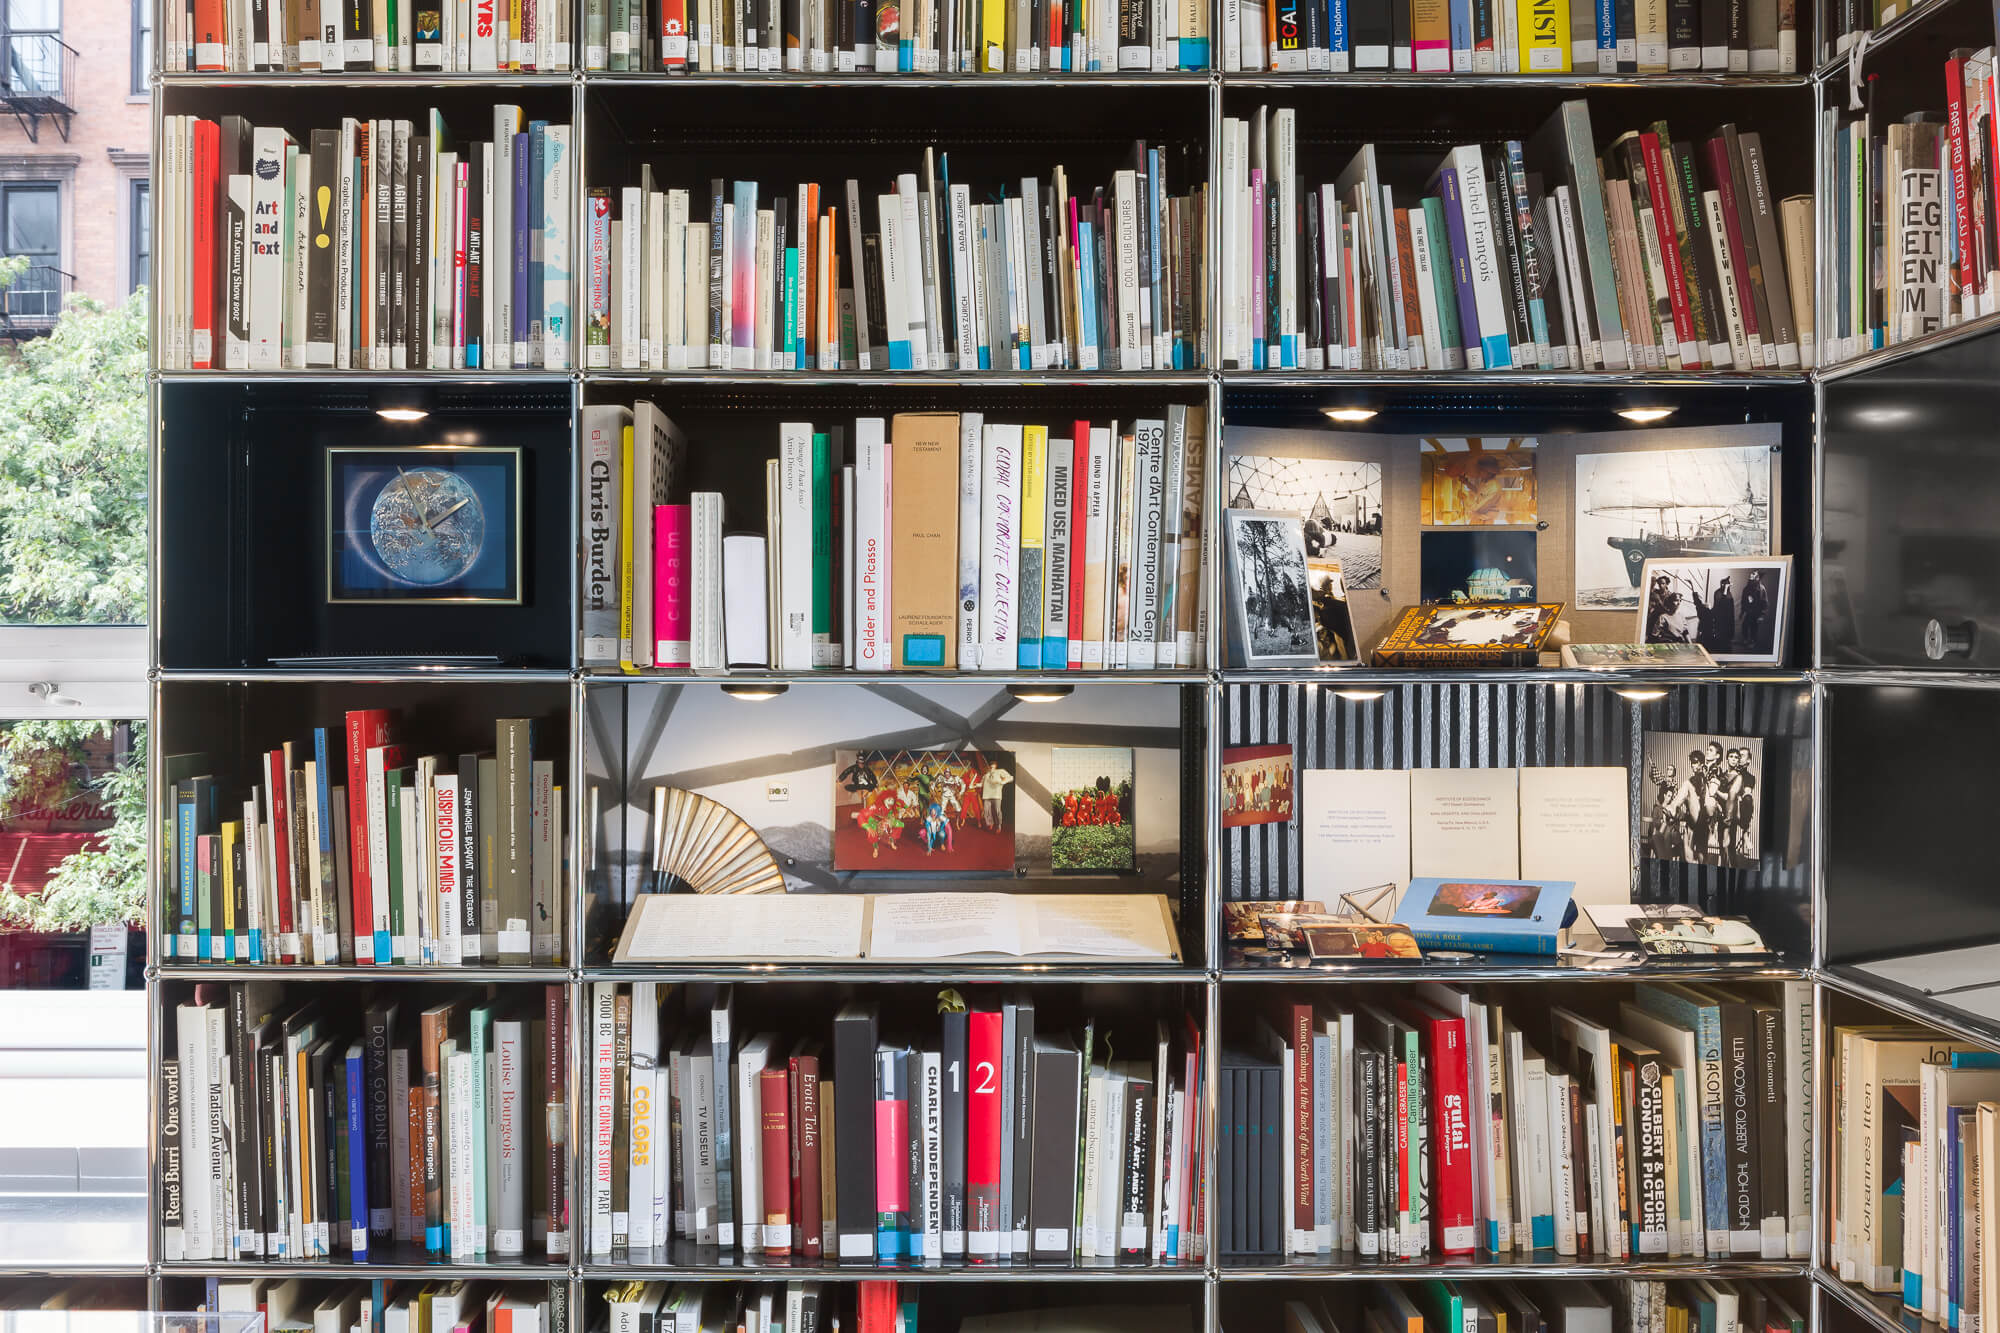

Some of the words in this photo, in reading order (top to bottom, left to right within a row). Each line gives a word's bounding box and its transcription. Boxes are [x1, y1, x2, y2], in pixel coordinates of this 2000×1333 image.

[1281, 0, 1299, 49] ECAL
[1949, 101, 1961, 136] PARS
[1749, 147, 1757, 157] EL
[1952, 137, 1963, 164] PRO
[341, 176, 351, 208] Graphic
[552, 169, 561, 200] Directory
[1464, 165, 1484, 216] Michel
[1498, 171, 1508, 198] NATURE
[1510, 148, 1531, 216] LITTLE
[1751, 158, 1764, 197] SOURDOG
[1954, 164, 1966, 199] TOTO
[256, 201, 278, 215] Art
[378, 184, 389, 223] AGNETTI
[394, 184, 406, 223] AGNETTI
[1122, 200, 1132, 240] CULTURES
[1501, 200, 1510, 221] OVER
[1758, 198, 1767, 216] HEX
[233, 220, 242, 239] The
[255, 220, 278, 235] and
[341, 208, 350, 239] Design:
[470, 217, 480, 230] ART
[594, 219, 603, 252] SWISS
[956, 220, 965, 229] IN
[1505, 222, 1514, 246] AGAIN
[232, 239, 242, 275] Armory
[252, 241, 280, 255] Text
[342, 240, 350, 256] Now
[470, 231, 481, 264] ANTI-ART
[957, 230, 966, 252] DADA
[1123, 243, 1132, 264] CLUB
[1473, 221, 1494, 283] François
[1520, 221, 1541, 294] SPARTA
[341, 257, 349, 266] in
[1419, 254, 1428, 273] COLLAGE
[1510, 253, 1520, 274] JOHN
[1712, 200, 1725, 233] BAD
[1720, 238, 1731, 270] NEW
[1726, 276, 1739, 319] DAYS
[233, 276, 242, 301] Show
[340, 267, 348, 310] Production
[594, 254, 604, 309] WATCHING
[1124, 268, 1133, 288] COOL
[1513, 275, 1523, 300] DIXON
[232, 302, 240, 322] 2008
[1517, 301, 1526, 324] HUNT
[786, 436, 795, 455] Artist
[1137, 427, 1149, 456] 1974
[1149, 427, 1164, 473] Centre
[786, 457, 795, 491] Directory
[995, 446, 1012, 487] GLOBAL
[1093, 455, 1102, 477] BOUND
[589, 460, 610, 522] Chris
[1052, 466, 1067, 508] MIXED
[1093, 480, 1102, 490] TO
[1148, 475, 1163, 506] d'Art
[1092, 491, 1102, 518] APPEAR
[995, 494, 1012, 566] CORPORATE
[1050, 510, 1067, 541] USE,
[590, 526, 611, 611] Burden
[864, 539, 876, 584] Picasso
[1142, 510, 1160, 607] Contemporain
[668, 531, 680, 621] cream
[1050, 543, 1066, 622] MANHATTAN
[866, 589, 876, 611] and
[995, 572, 1012, 642] COLLECTION
[863, 615, 876, 660] Calder
[542, 773, 550, 804] Touching
[437, 789, 454, 852] SUSPICIOUS
[463, 787, 474, 835] JEAN-MICHEL
[463, 836, 475, 870] BASQUIAT
[465, 874, 474, 888] THE
[465, 888, 476, 927] NOTEBOOKS
[600, 993, 612, 1020] 2000
[616, 1005, 628, 1035] CHEN
[599, 1022, 612, 1037] BC
[1300, 1015, 1309, 1042] Anton
[1766, 1014, 1775, 1050] Alberto
[372, 1025, 385, 1071] DORA
[501, 1040, 515, 1085] Louise
[598, 1042, 611, 1064] THE
[616, 1038, 629, 1067] ZHEN
[1299, 1043, 1310, 1083] Ginzburg
[598, 1066, 611, 1102] BRUCE
[949, 1060, 960, 1093] 1
[975, 1061, 996, 1094] 2
[1408, 1049, 1418, 1087] Graeser
[1766, 1051, 1776, 1103] Giacometti
[164, 1065, 181, 1106] world
[803, 1073, 817, 1112] Erotic
[928, 1065, 938, 1134] CHARLEY
[1300, 1084, 1310, 1094] At
[1300, 1095, 1310, 1108] the
[1399, 1080, 1407, 1114] GRAESER
[1705, 1048, 1721, 1132] GIACOMETTI
[164, 1107, 181, 1136] One
[209, 1083, 222, 1134] Madison
[374, 1077, 388, 1150] GORDINE
[426, 1106, 435, 1135] Louise
[698, 1106, 708, 1119] TV
[1132, 1098, 1143, 1145] WOMEN,
[1300, 1110, 1310, 1132] Back
[1408, 1088, 1418, 1124] Camille
[1443, 1094, 1469, 1151] gutai
[1641, 1086, 1653, 1157] LONDON
[1652, 1086, 1664, 1156] GILBERT
[1862, 1082, 1872, 1129] Itten
[499, 1090, 516, 1159] Bourgeois
[598, 1105, 611, 1146] CONNER
[632, 1085, 650, 1167] COLORS
[804, 1115, 817, 1147] Tales
[1299, 1132, 1310, 1142] of
[1399, 1116, 1407, 1149] CAMILLE
[210, 1135, 223, 1180] Avenue
[426, 1136, 436, 1180] Bourgeois
[698, 1121, 708, 1167] MUSEUM
[1131, 1146, 1142, 1170] ART,
[1301, 1143, 1310, 1157] the
[164, 1146, 180, 1182] Burri
[598, 1149, 611, 1183] STORY
[1301, 1158, 1311, 1182] North
[1653, 1161, 1664, 1173] &
[1131, 1171, 1141, 1194] AND
[1301, 1183, 1311, 1206] Wind
[1643, 1162, 1656, 1233] PICTURE
[1862, 1135, 1872, 1242] Johannes
[164, 1184, 180, 1221] René
[597, 1189, 611, 1216] PART
